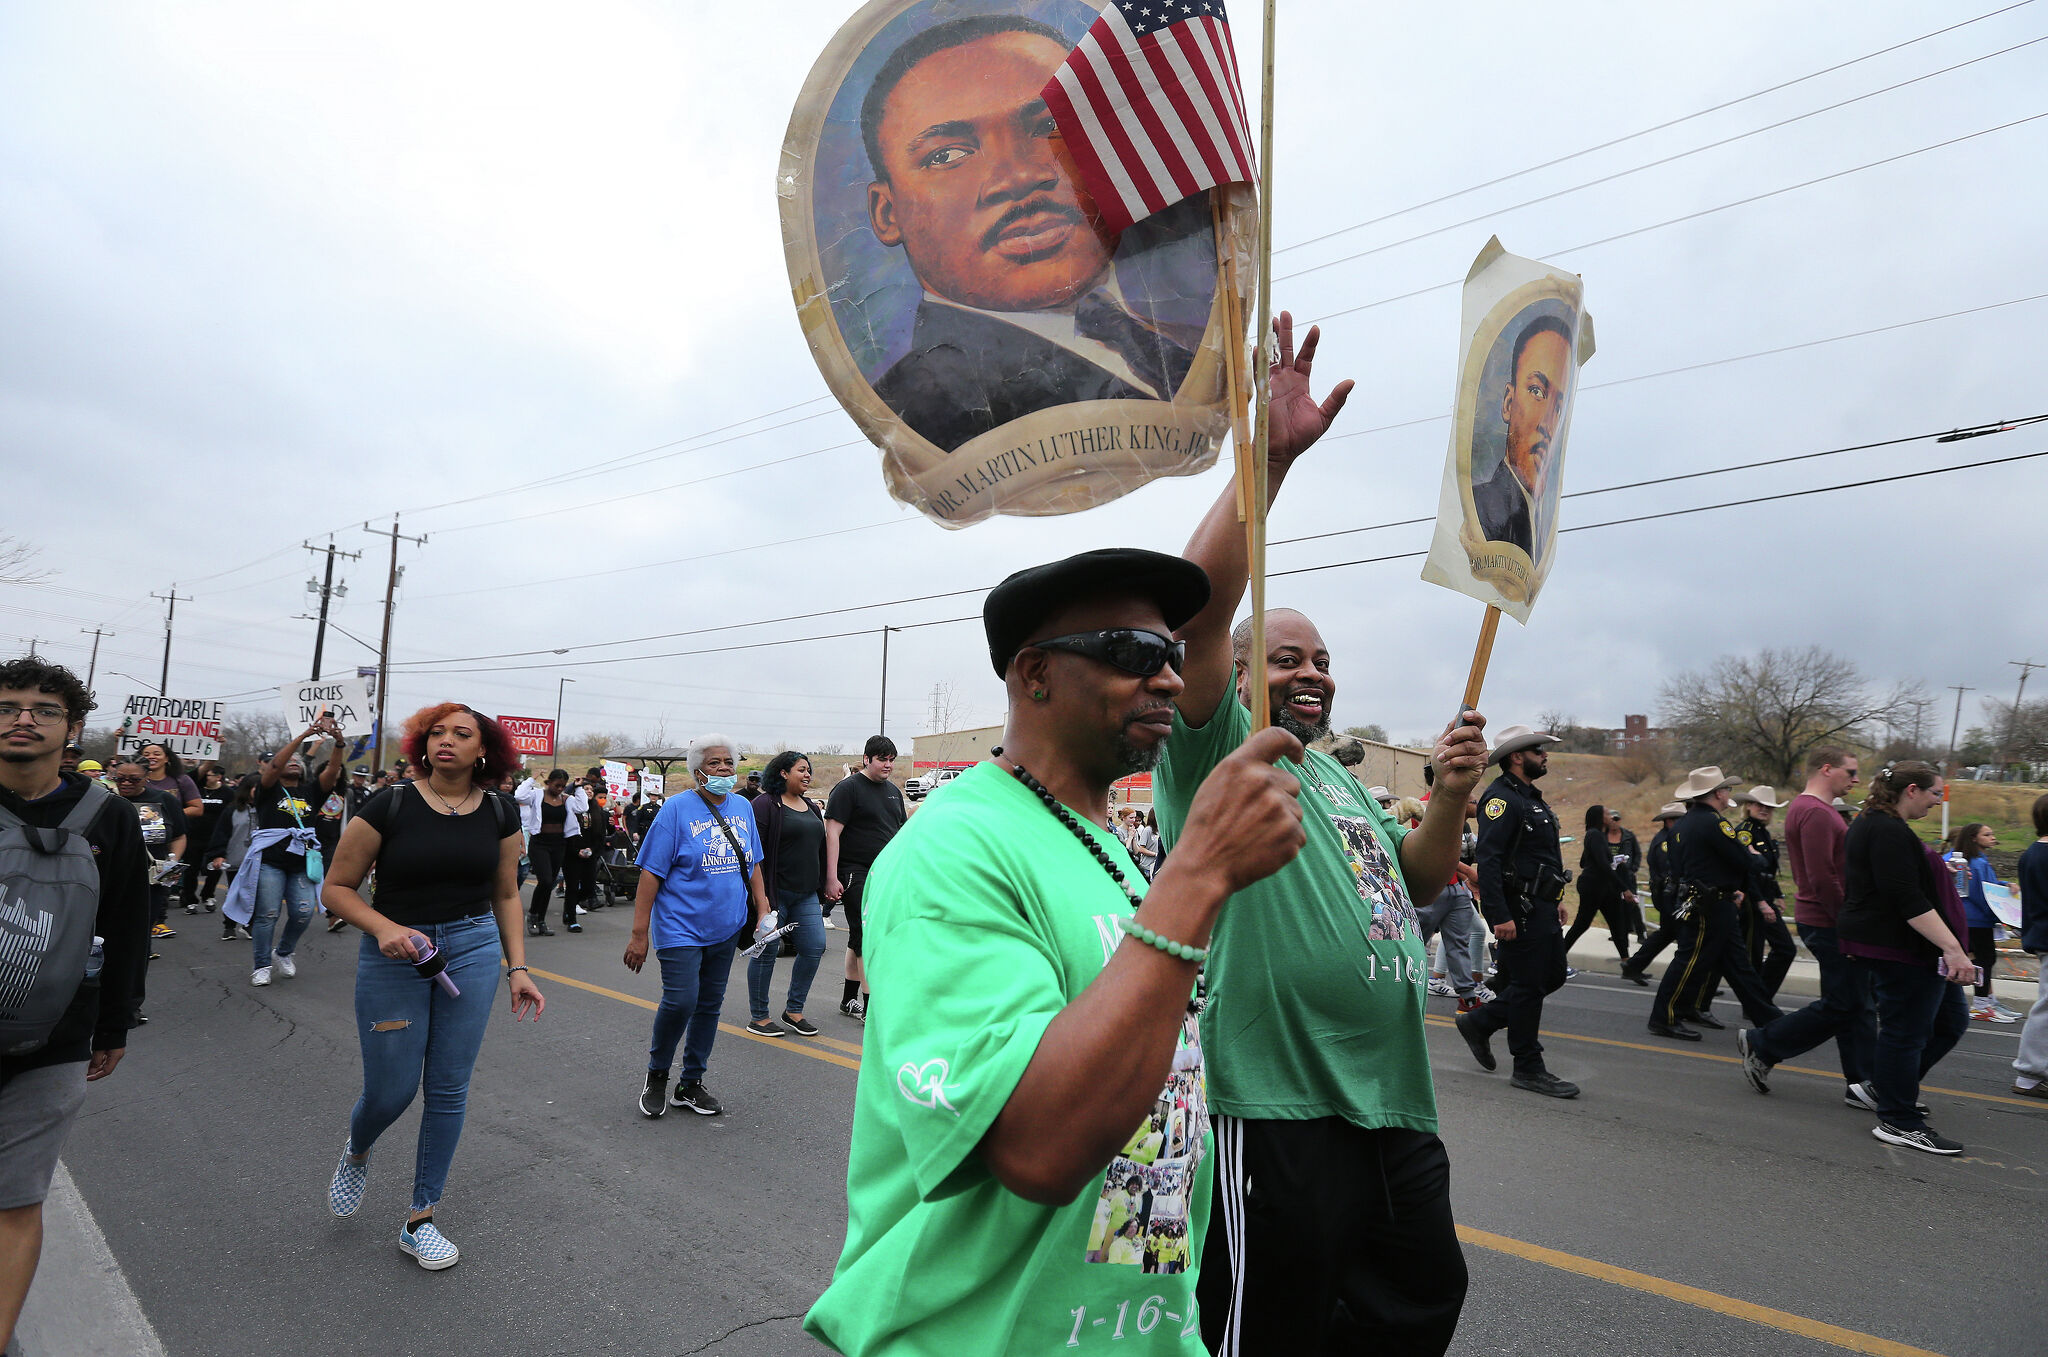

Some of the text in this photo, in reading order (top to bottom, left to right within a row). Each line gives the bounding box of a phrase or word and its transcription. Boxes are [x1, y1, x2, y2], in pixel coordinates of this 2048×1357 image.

[930, 489, 965, 519] DR.
[955, 443, 1038, 500] MARTIN
[1039, 425, 1124, 463] LUTHER
[1129, 424, 1182, 455] KING,
[1484, 553, 1509, 569] MARTIN
[298, 684, 344, 702] CIRCLES
[123, 694, 225, 721] AFFORDABLE
[298, 705, 317, 723] IN
[136, 715, 221, 741] HOUSING
[501, 719, 552, 737] FAMILY
[511, 735, 549, 752] OLLAR
[701, 848, 753, 867] ANNIVERSRY
